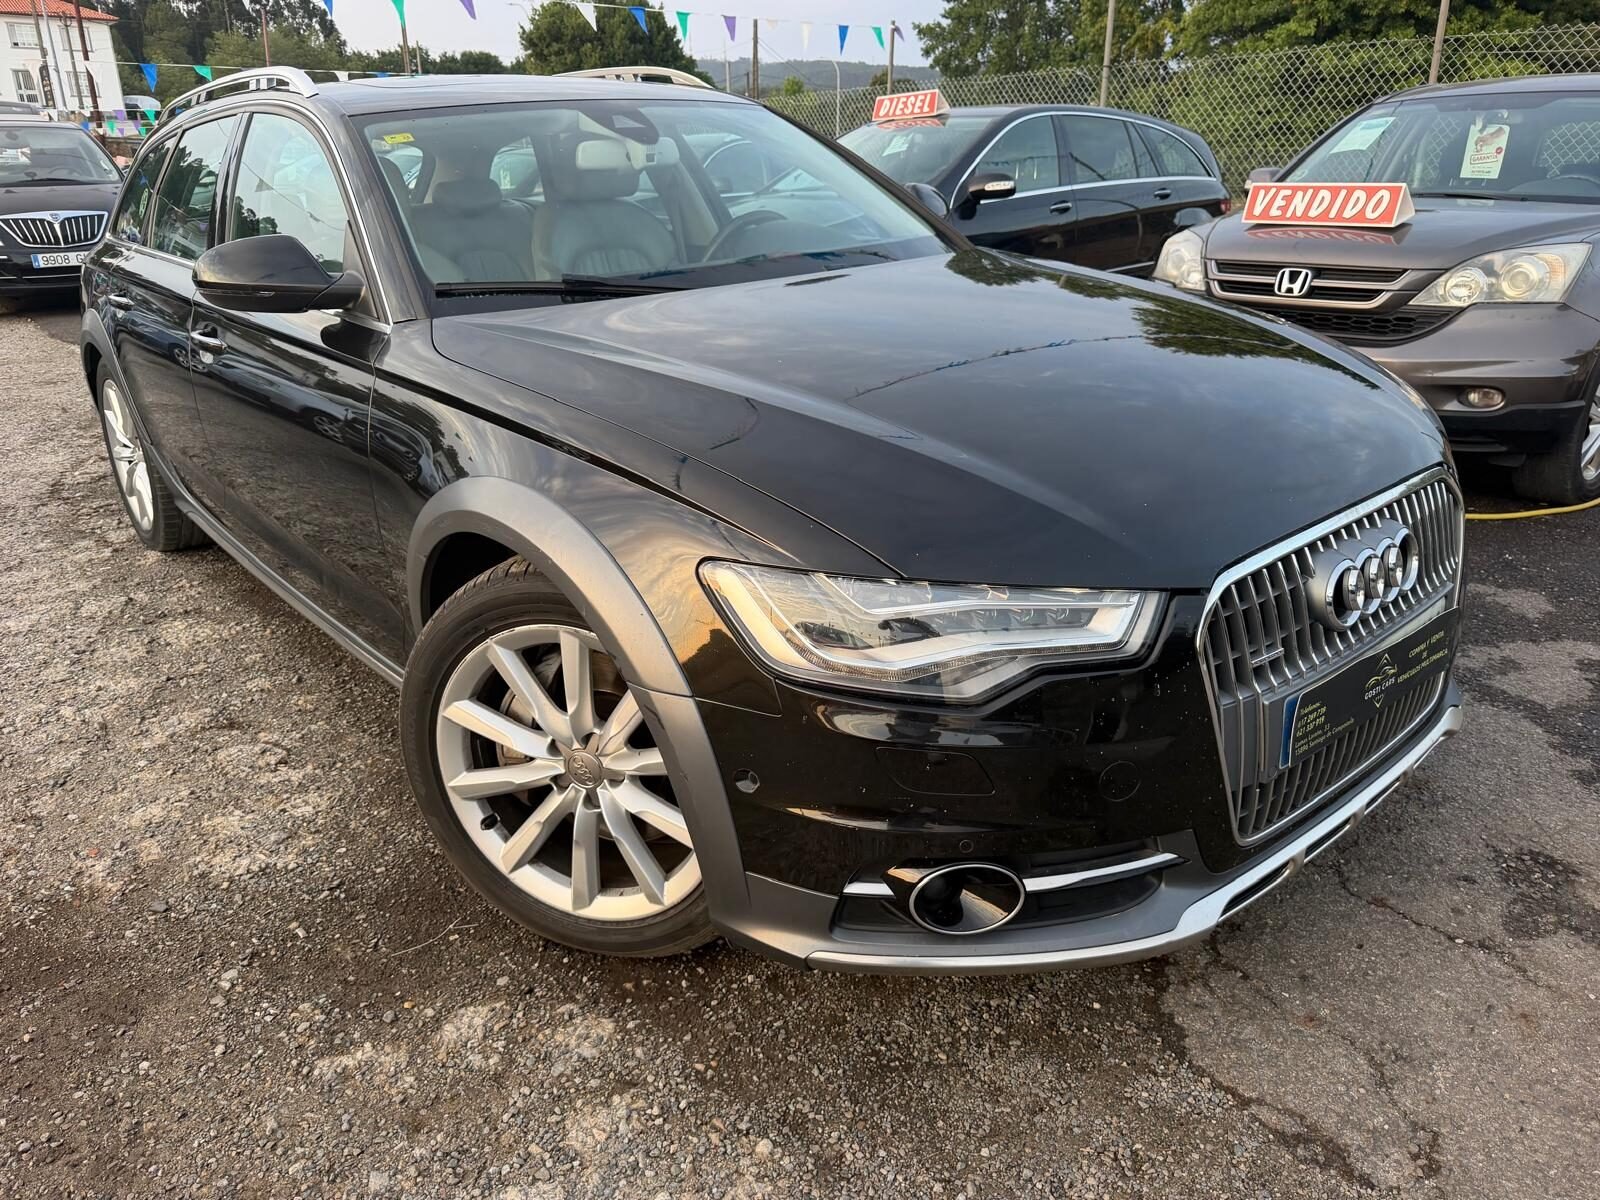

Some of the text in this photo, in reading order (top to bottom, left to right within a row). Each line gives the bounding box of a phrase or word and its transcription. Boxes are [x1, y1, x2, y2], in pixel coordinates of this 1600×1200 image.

[879, 94, 931, 117] DIESEL
[1253, 187, 1391, 220] VENDIDO
[41, 254, 70, 266] 9908
